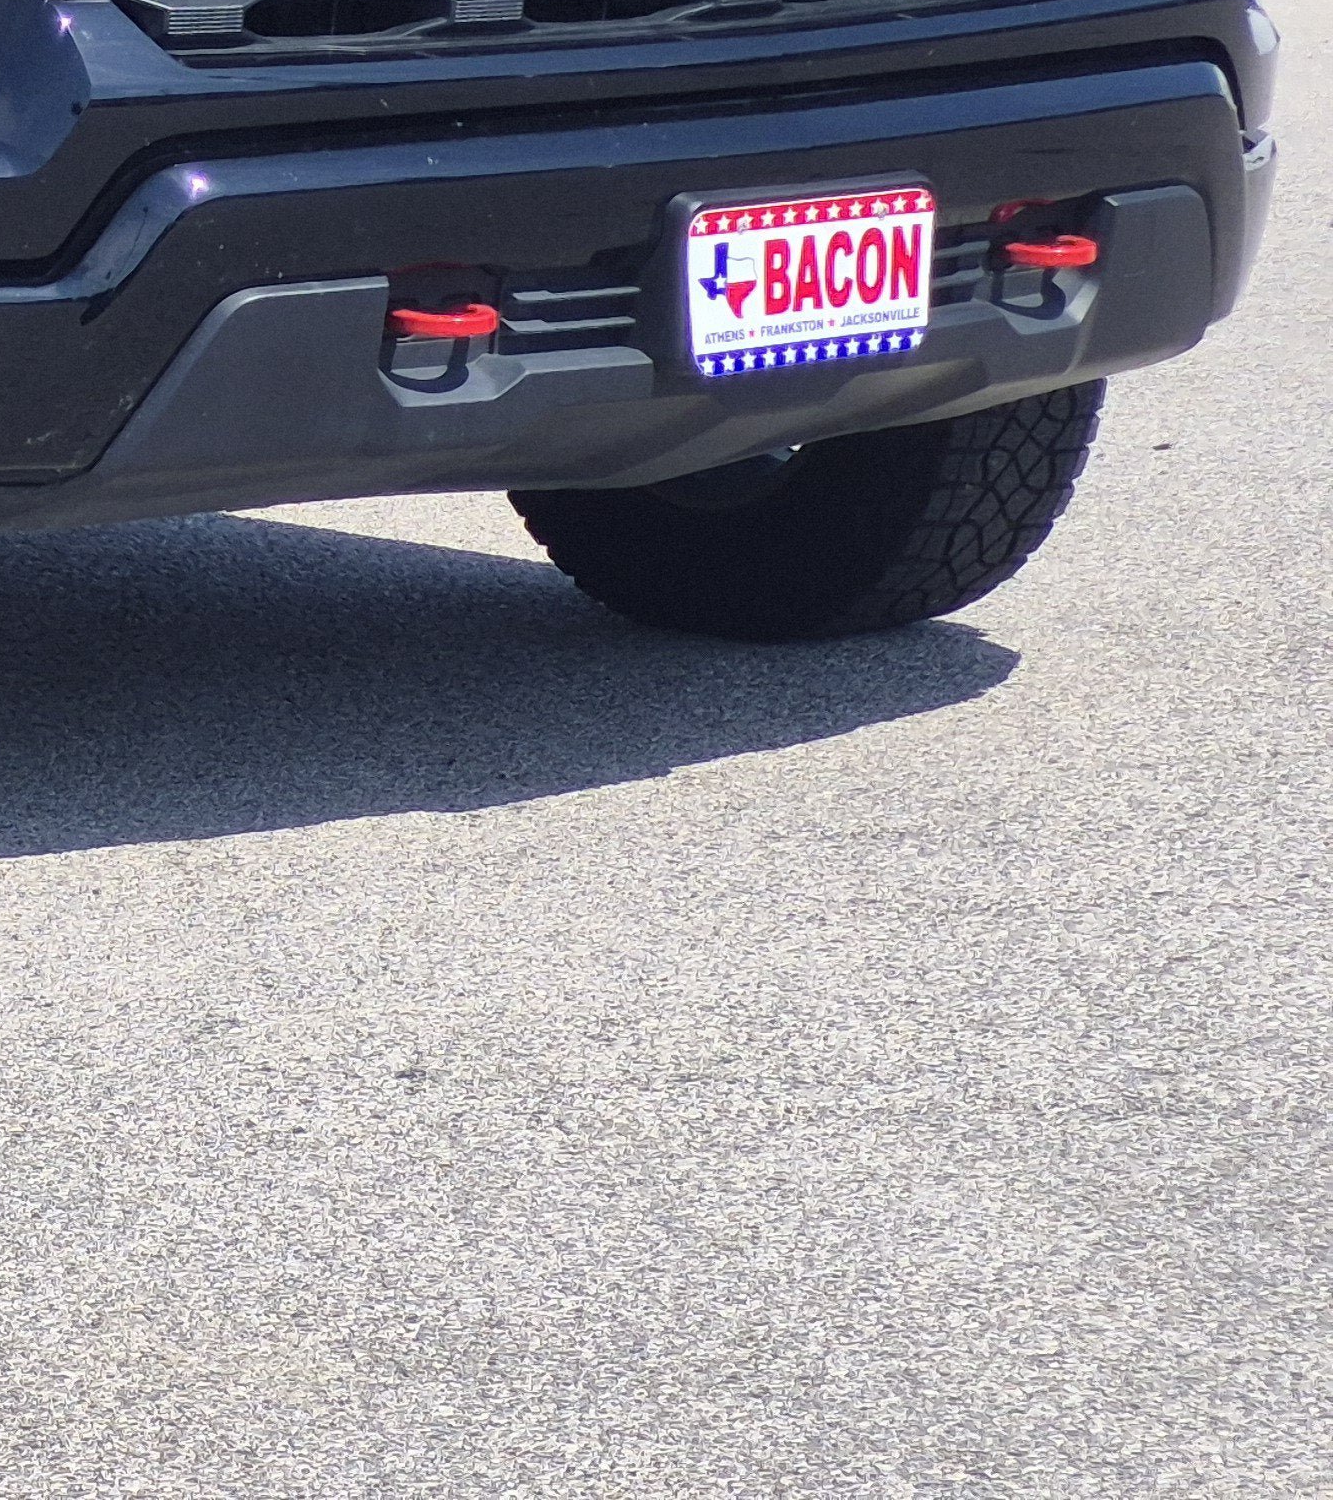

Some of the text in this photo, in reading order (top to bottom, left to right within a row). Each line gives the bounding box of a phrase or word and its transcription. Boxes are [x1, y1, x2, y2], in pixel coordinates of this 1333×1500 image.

[763, 223, 922, 316] BACON
[704, 306, 921, 345] ATHENS FRANKSTON JACKSONVILLE
